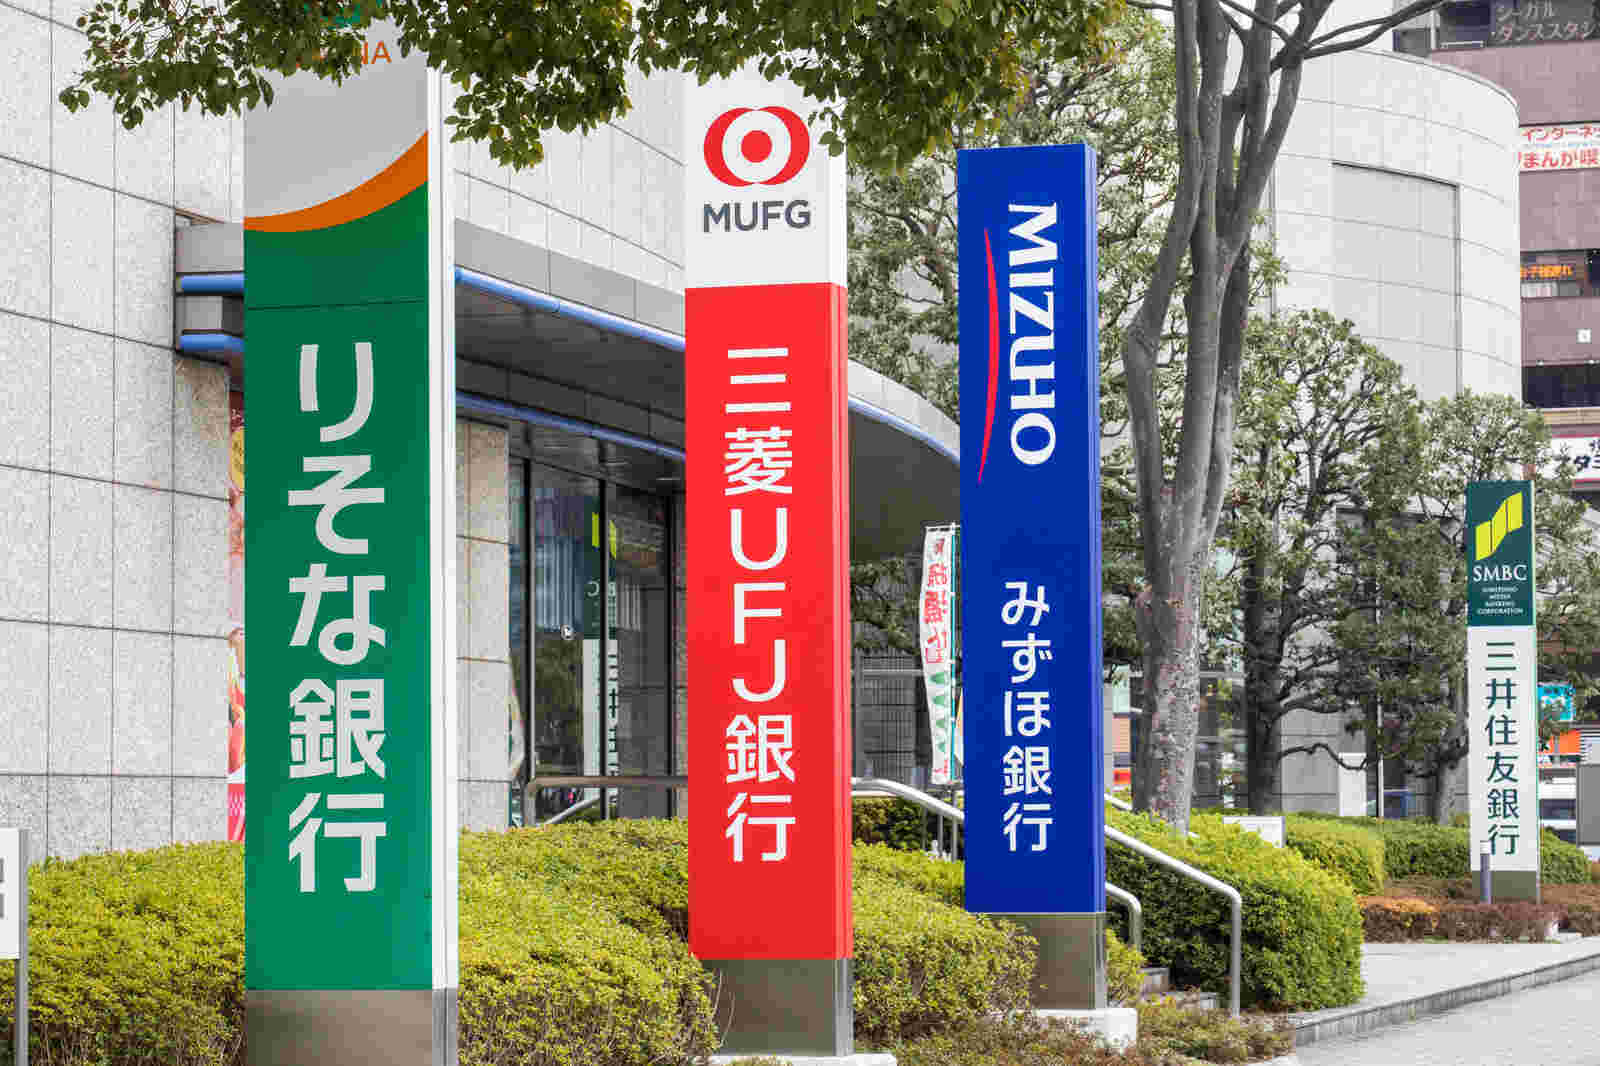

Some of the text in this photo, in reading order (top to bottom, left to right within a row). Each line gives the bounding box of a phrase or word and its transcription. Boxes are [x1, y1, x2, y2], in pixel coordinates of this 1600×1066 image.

[703, 199, 812, 233] MUFG
[1007, 202, 1059, 466] MIZUHO
[287, 341, 388, 893] りそな銀行
[724, 346, 797, 863] 三菱UFJ銀行
[1472, 564, 1528, 582] SMBC
[1000, 580, 1054, 852] みずほ銀行
[1484, 640, 1521, 856] 三井住友銀行
